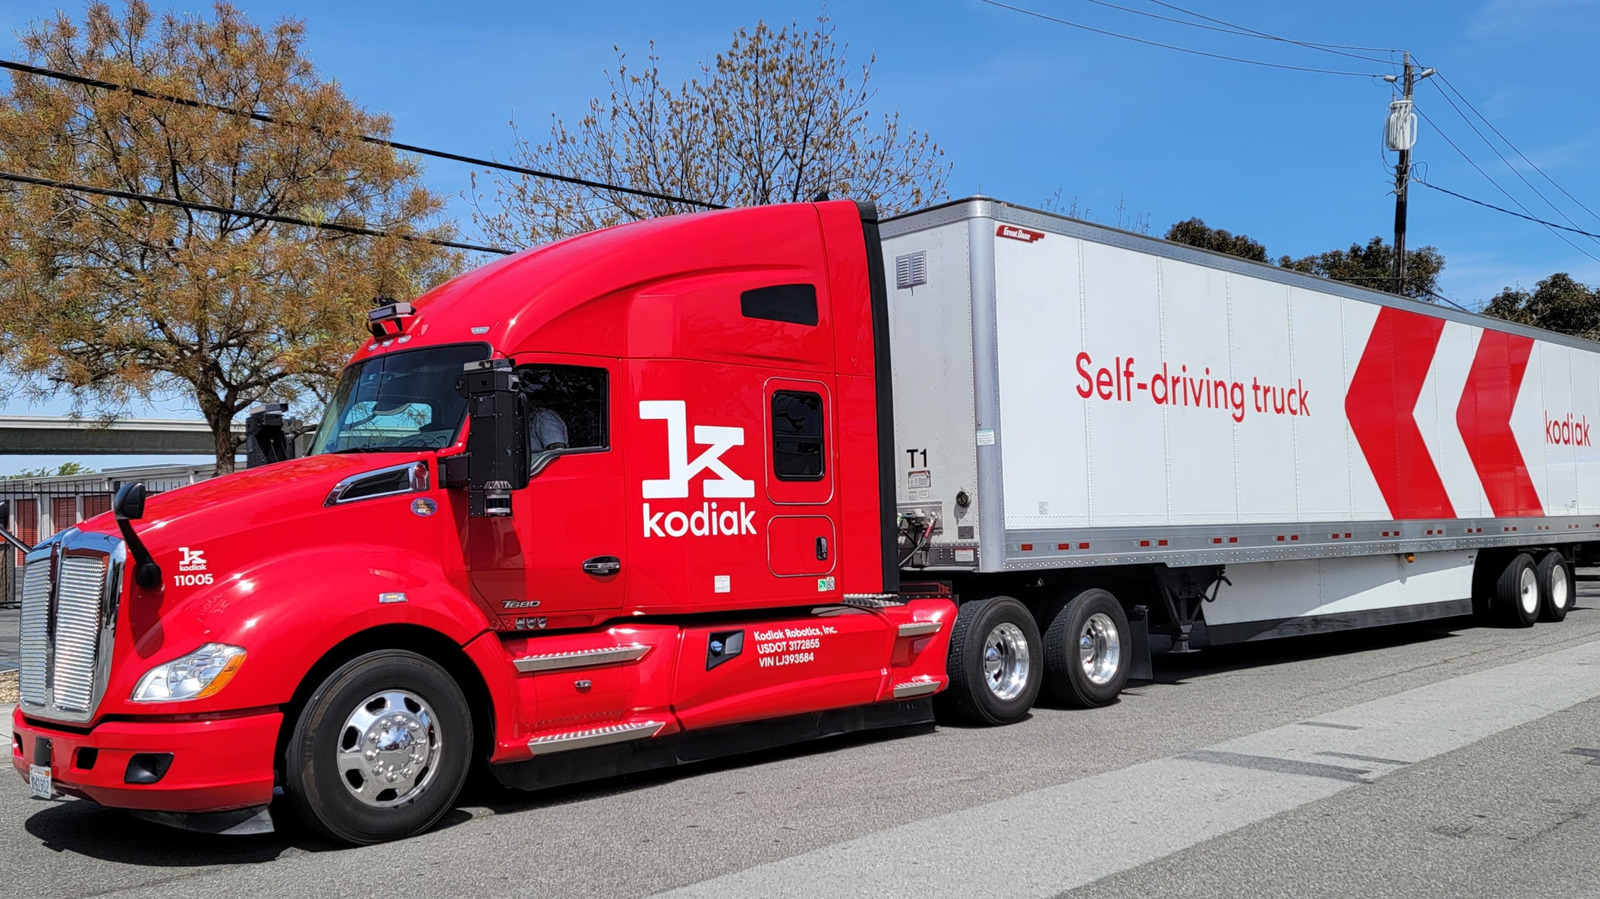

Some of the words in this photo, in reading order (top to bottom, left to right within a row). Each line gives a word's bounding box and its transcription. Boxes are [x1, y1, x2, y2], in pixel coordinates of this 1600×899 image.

[1075, 351, 1246, 423] Self-driving
[1251, 377, 1311, 416] truck
[1544, 410, 1591, 446] kodiak
[906, 448, 927, 468] T1
[642, 501, 757, 538] kodiak
[179, 564, 207, 572] kodiak
[173, 573, 214, 587] 11005
[501, 600, 541, 609] T680
[753, 629, 785, 642] Kodiak
[784, 627, 823, 638] Robotics,
[822, 624, 838, 635] Inc.
[756, 641, 787, 654] USDOT
[788, 638, 820, 651] 3172855
[758, 656, 774, 667] VIN
[775, 652, 814, 666] LJ393584
